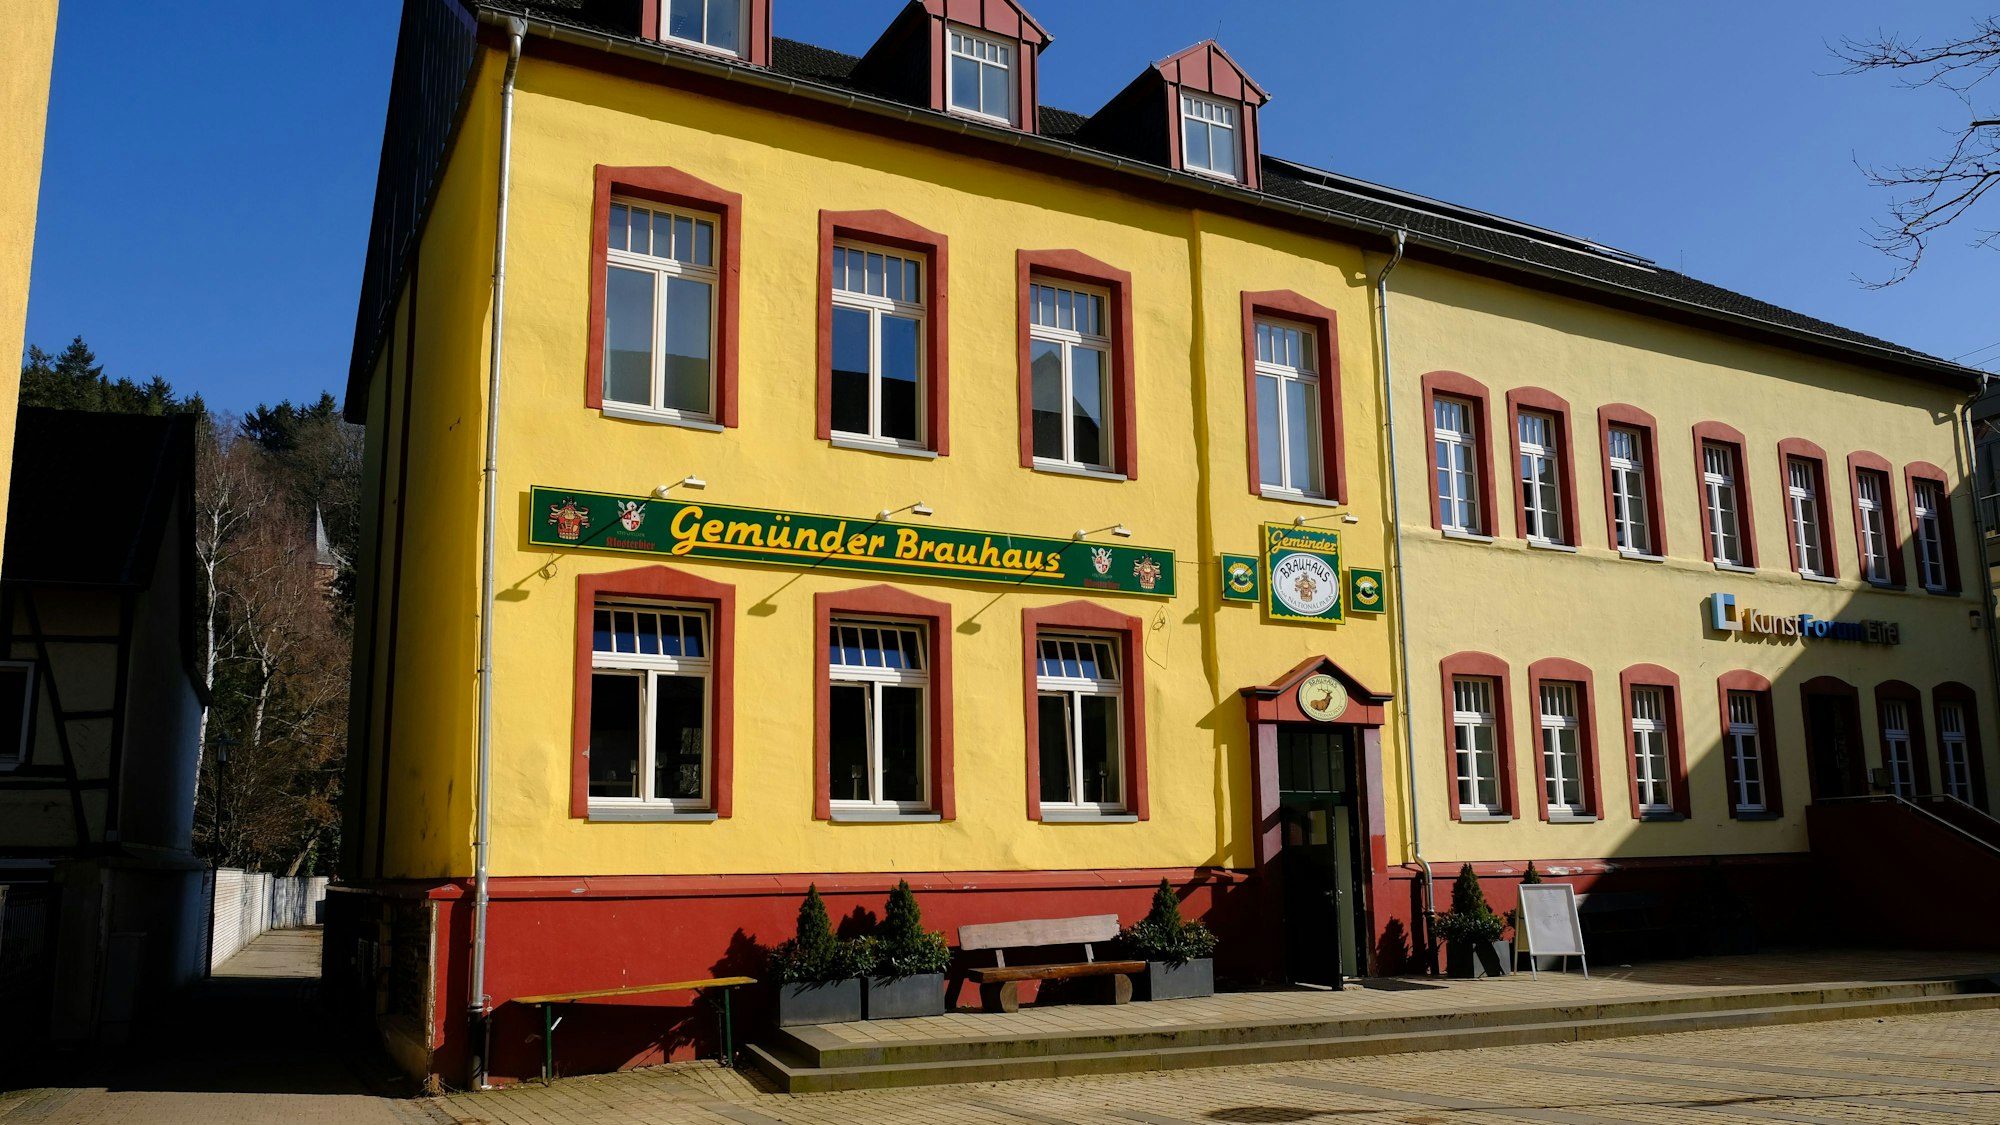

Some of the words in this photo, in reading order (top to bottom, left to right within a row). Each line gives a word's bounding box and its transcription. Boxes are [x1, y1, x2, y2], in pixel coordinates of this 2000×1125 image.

[670, 505, 886, 557] Gemünder
[895, 528, 1062, 573] Brauhaus
[1271, 530, 1337, 554] Gemünder
[1280, 558, 1331, 583] BRAUHAUS
[1287, 592, 1334, 610] NATIONALPARK
